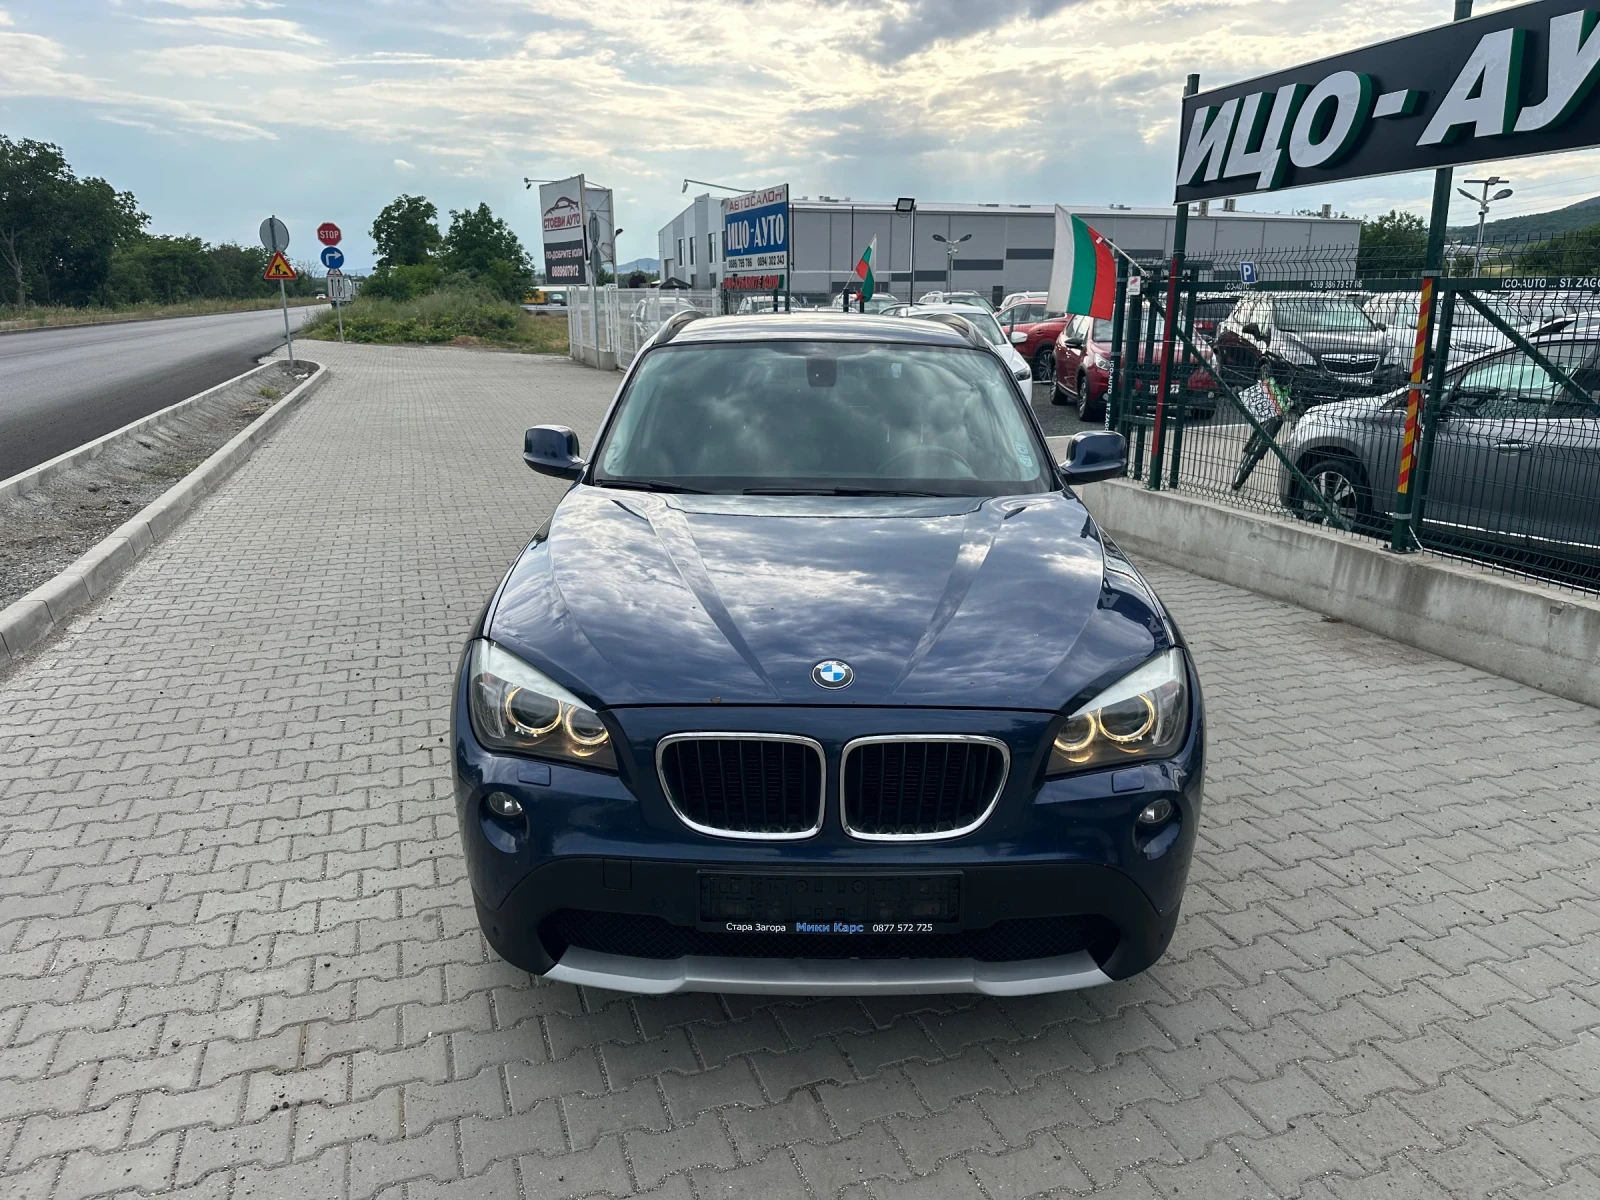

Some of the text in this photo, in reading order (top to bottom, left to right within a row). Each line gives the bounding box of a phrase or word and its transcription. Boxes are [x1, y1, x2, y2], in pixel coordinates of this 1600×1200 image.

[544, 214, 580, 229] СТОЕВИ АУТО
[320, 230, 339, 239] STOP
[728, 214, 785, 254] ИЦО-АУТО
[1243, 265, 1251, 280] P
[1560, 278, 1573, 288] ST.
[725, 922, 933, 934] Стара Загора Мики Карс 0877 572 725
